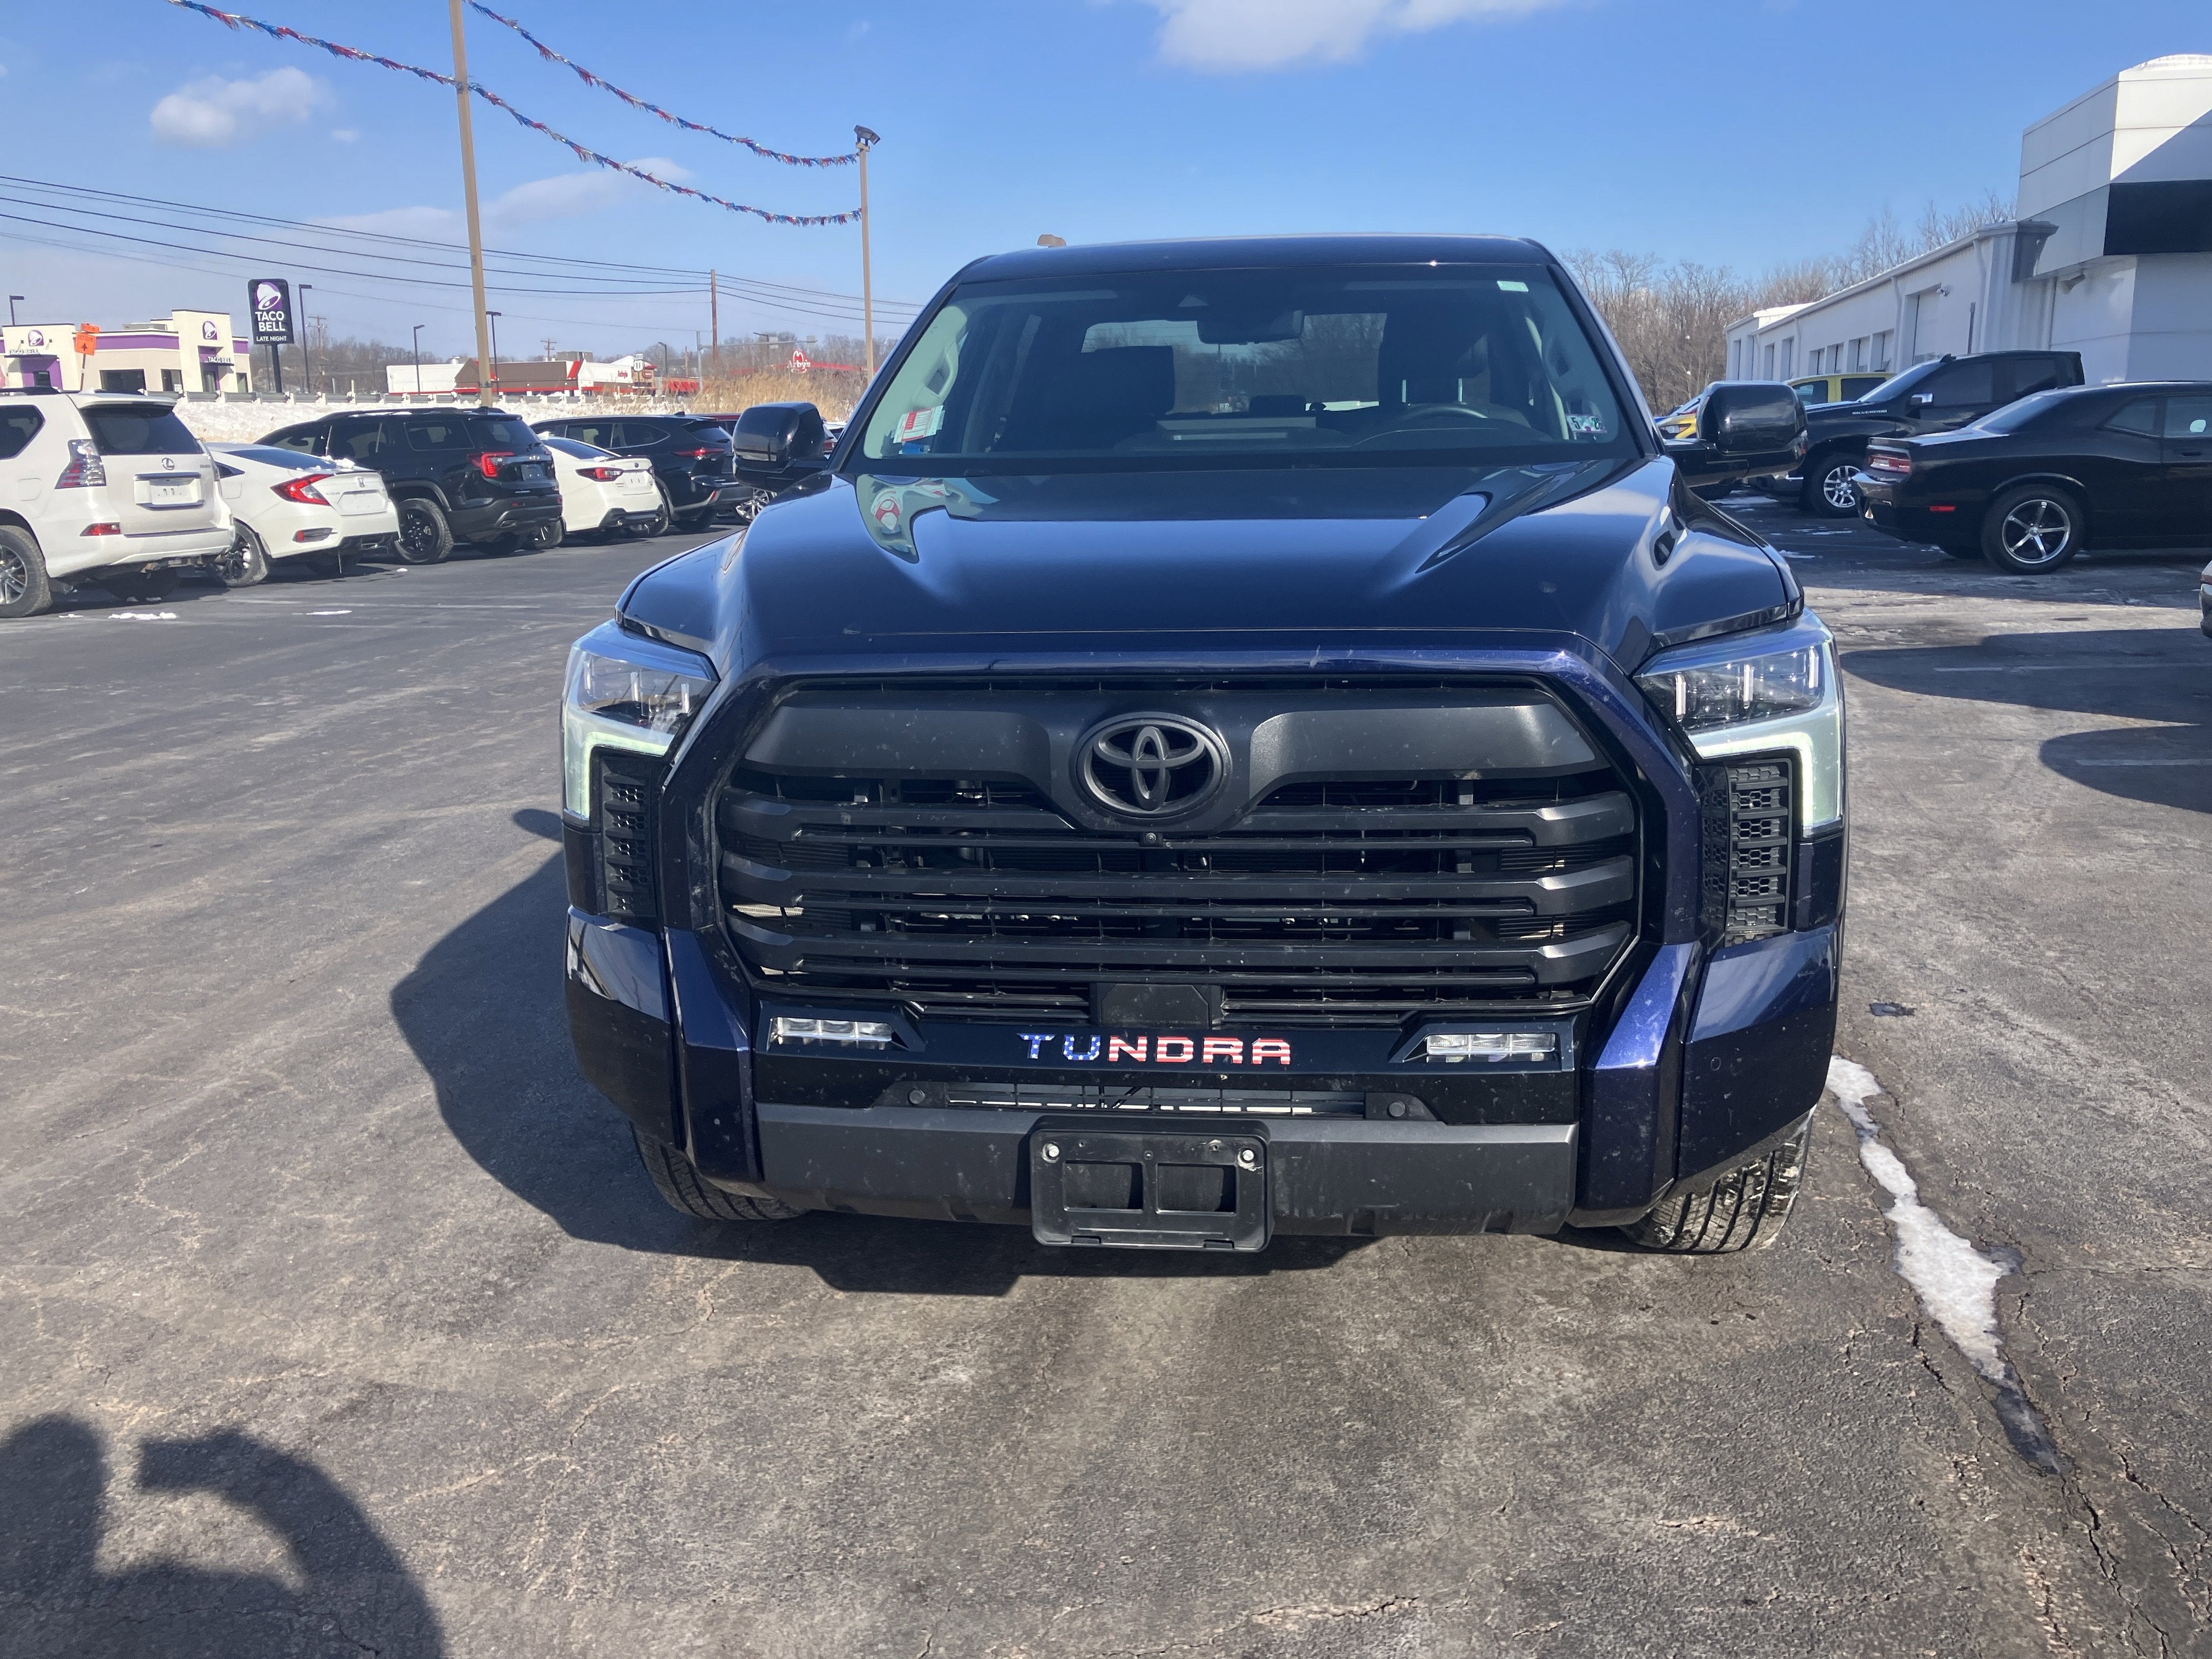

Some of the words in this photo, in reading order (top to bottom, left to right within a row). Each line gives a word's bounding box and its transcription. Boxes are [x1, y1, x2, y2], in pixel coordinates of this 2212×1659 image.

[255, 311, 285, 321] TACO
[258, 321, 286, 332] BELL
[1017, 1033, 1291, 1065] TUNDRA
